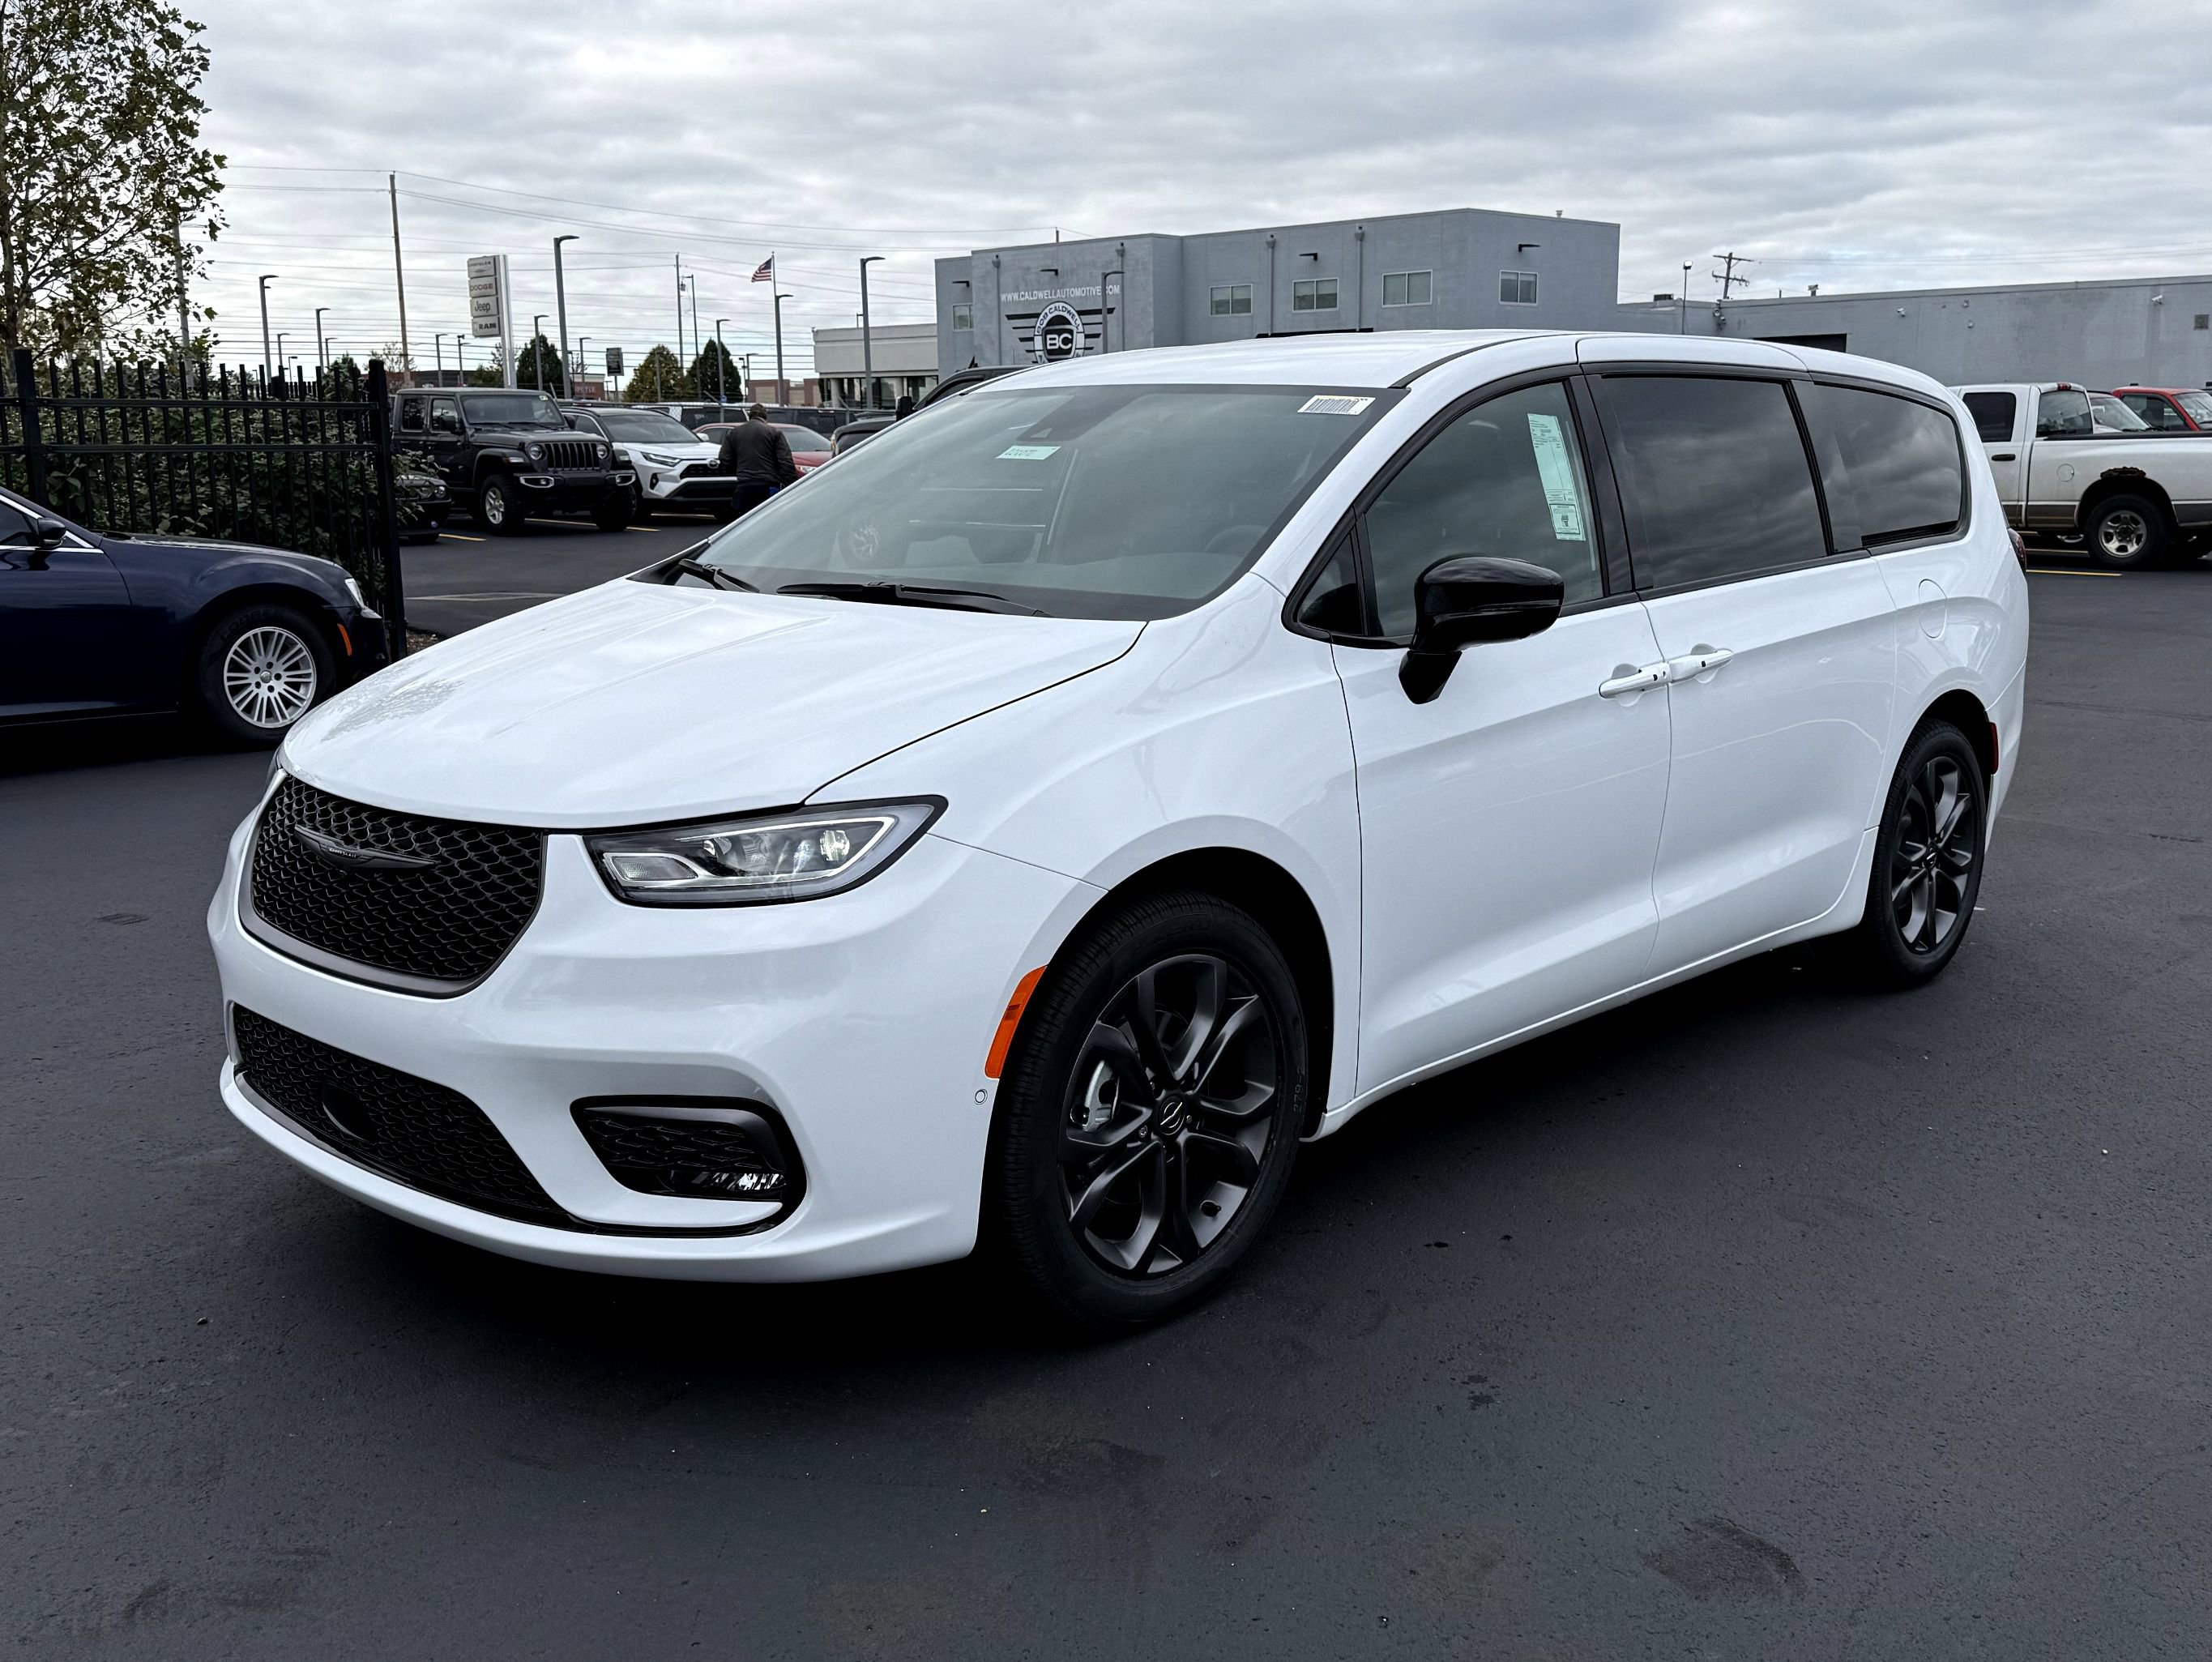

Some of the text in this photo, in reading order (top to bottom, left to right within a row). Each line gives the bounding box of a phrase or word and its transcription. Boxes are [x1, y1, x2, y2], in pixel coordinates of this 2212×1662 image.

[470, 284, 493, 292] DODGE
[1001, 285, 1121, 302] WWW.CALDWELLAUTOMOTIVEOM
[475, 301, 491, 313] Jeep
[1048, 305, 1081, 331] CALDWELL
[1046, 333, 1072, 350] BC
